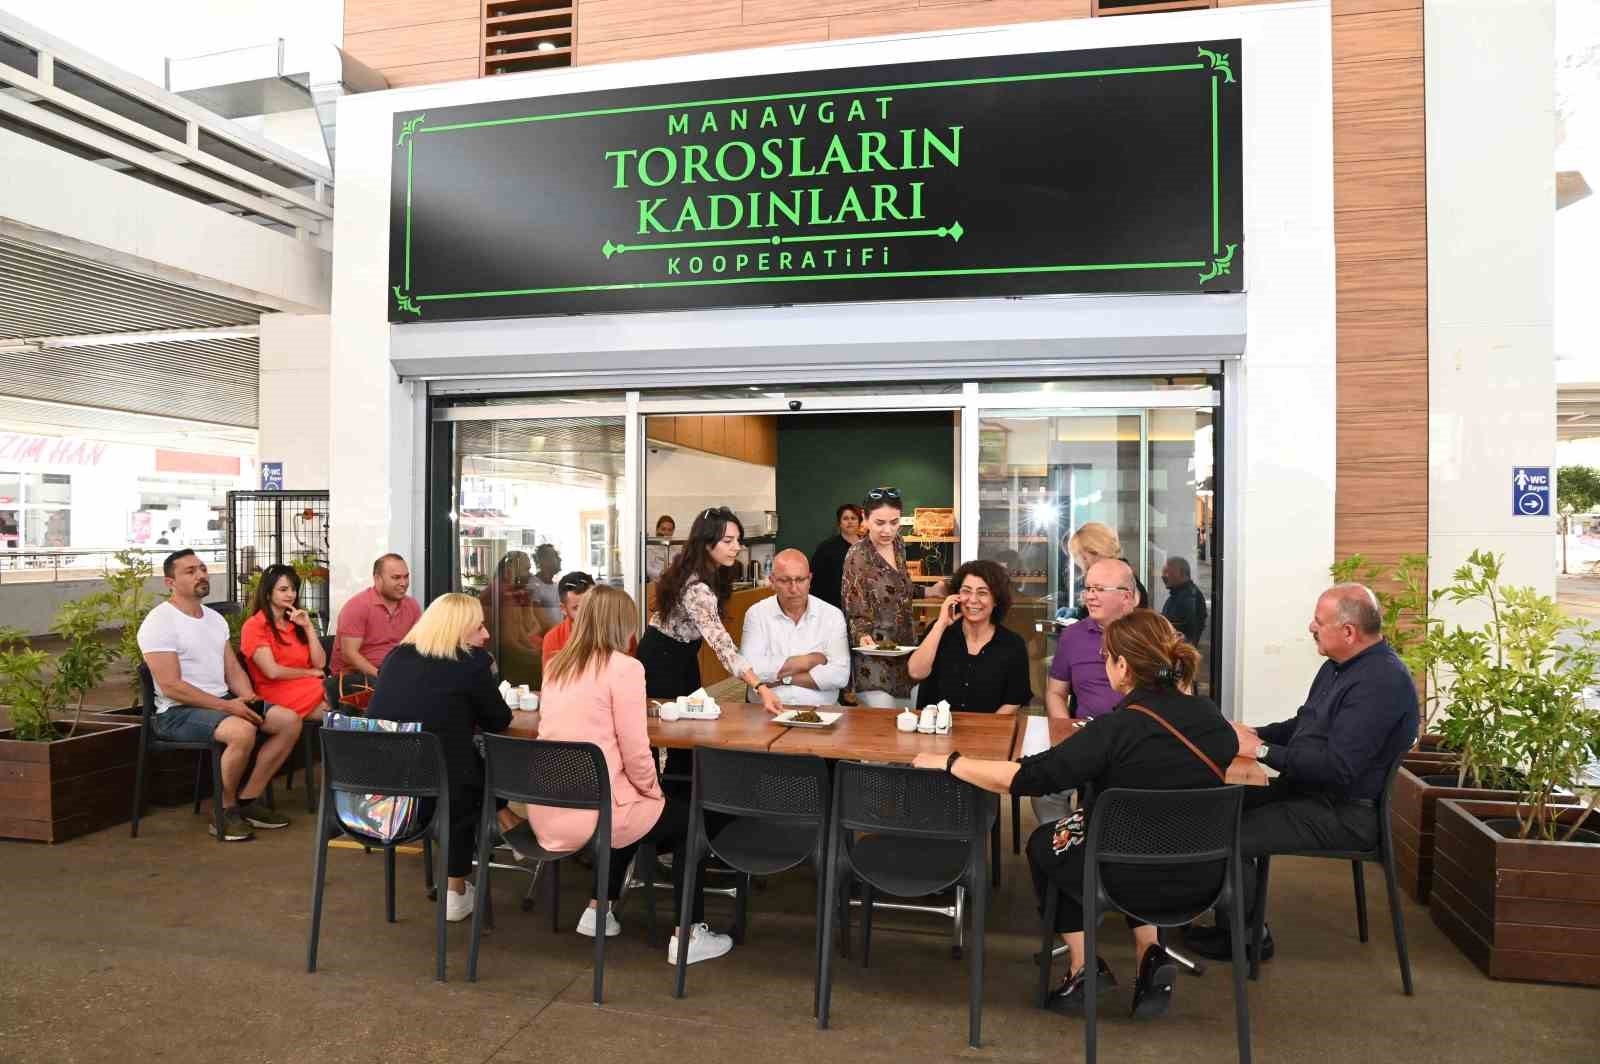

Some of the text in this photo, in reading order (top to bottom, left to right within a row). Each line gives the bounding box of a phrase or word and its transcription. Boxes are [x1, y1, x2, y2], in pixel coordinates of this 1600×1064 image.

[667, 96, 893, 136] MANAVGAT
[604, 126, 964, 189] TOROSLARIN
[636, 182, 926, 235] KADINLARI
[1530, 475, 1547, 484] WC
